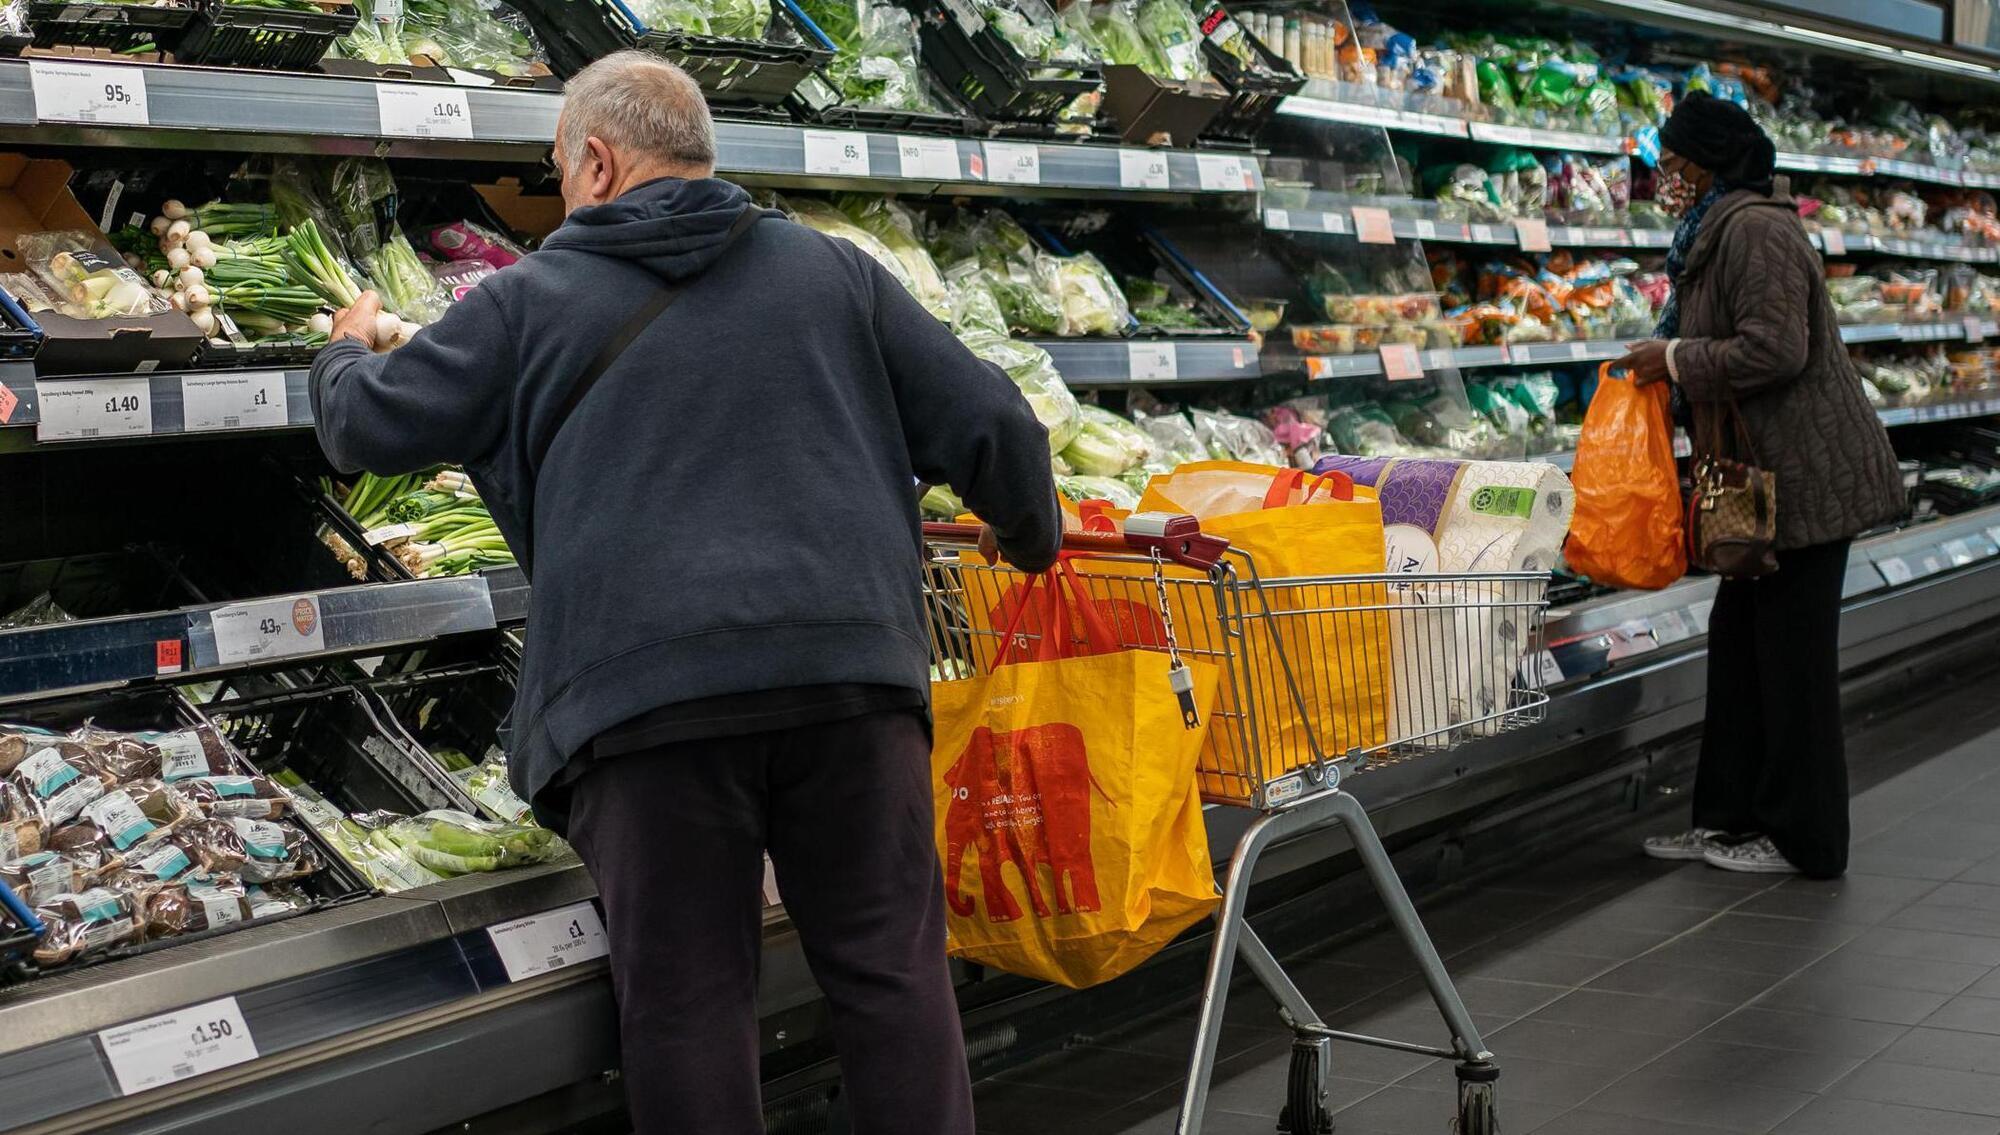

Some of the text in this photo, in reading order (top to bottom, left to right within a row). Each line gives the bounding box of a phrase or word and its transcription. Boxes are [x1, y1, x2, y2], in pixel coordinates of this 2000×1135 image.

[105, 84, 131, 104] 95p
[433, 103, 461, 117] £1.04
[105, 396, 139, 412] £1.40
[254, 388, 267, 405] £1
[260, 618, 282, 635] 43p
[568, 920, 584, 938] £1
